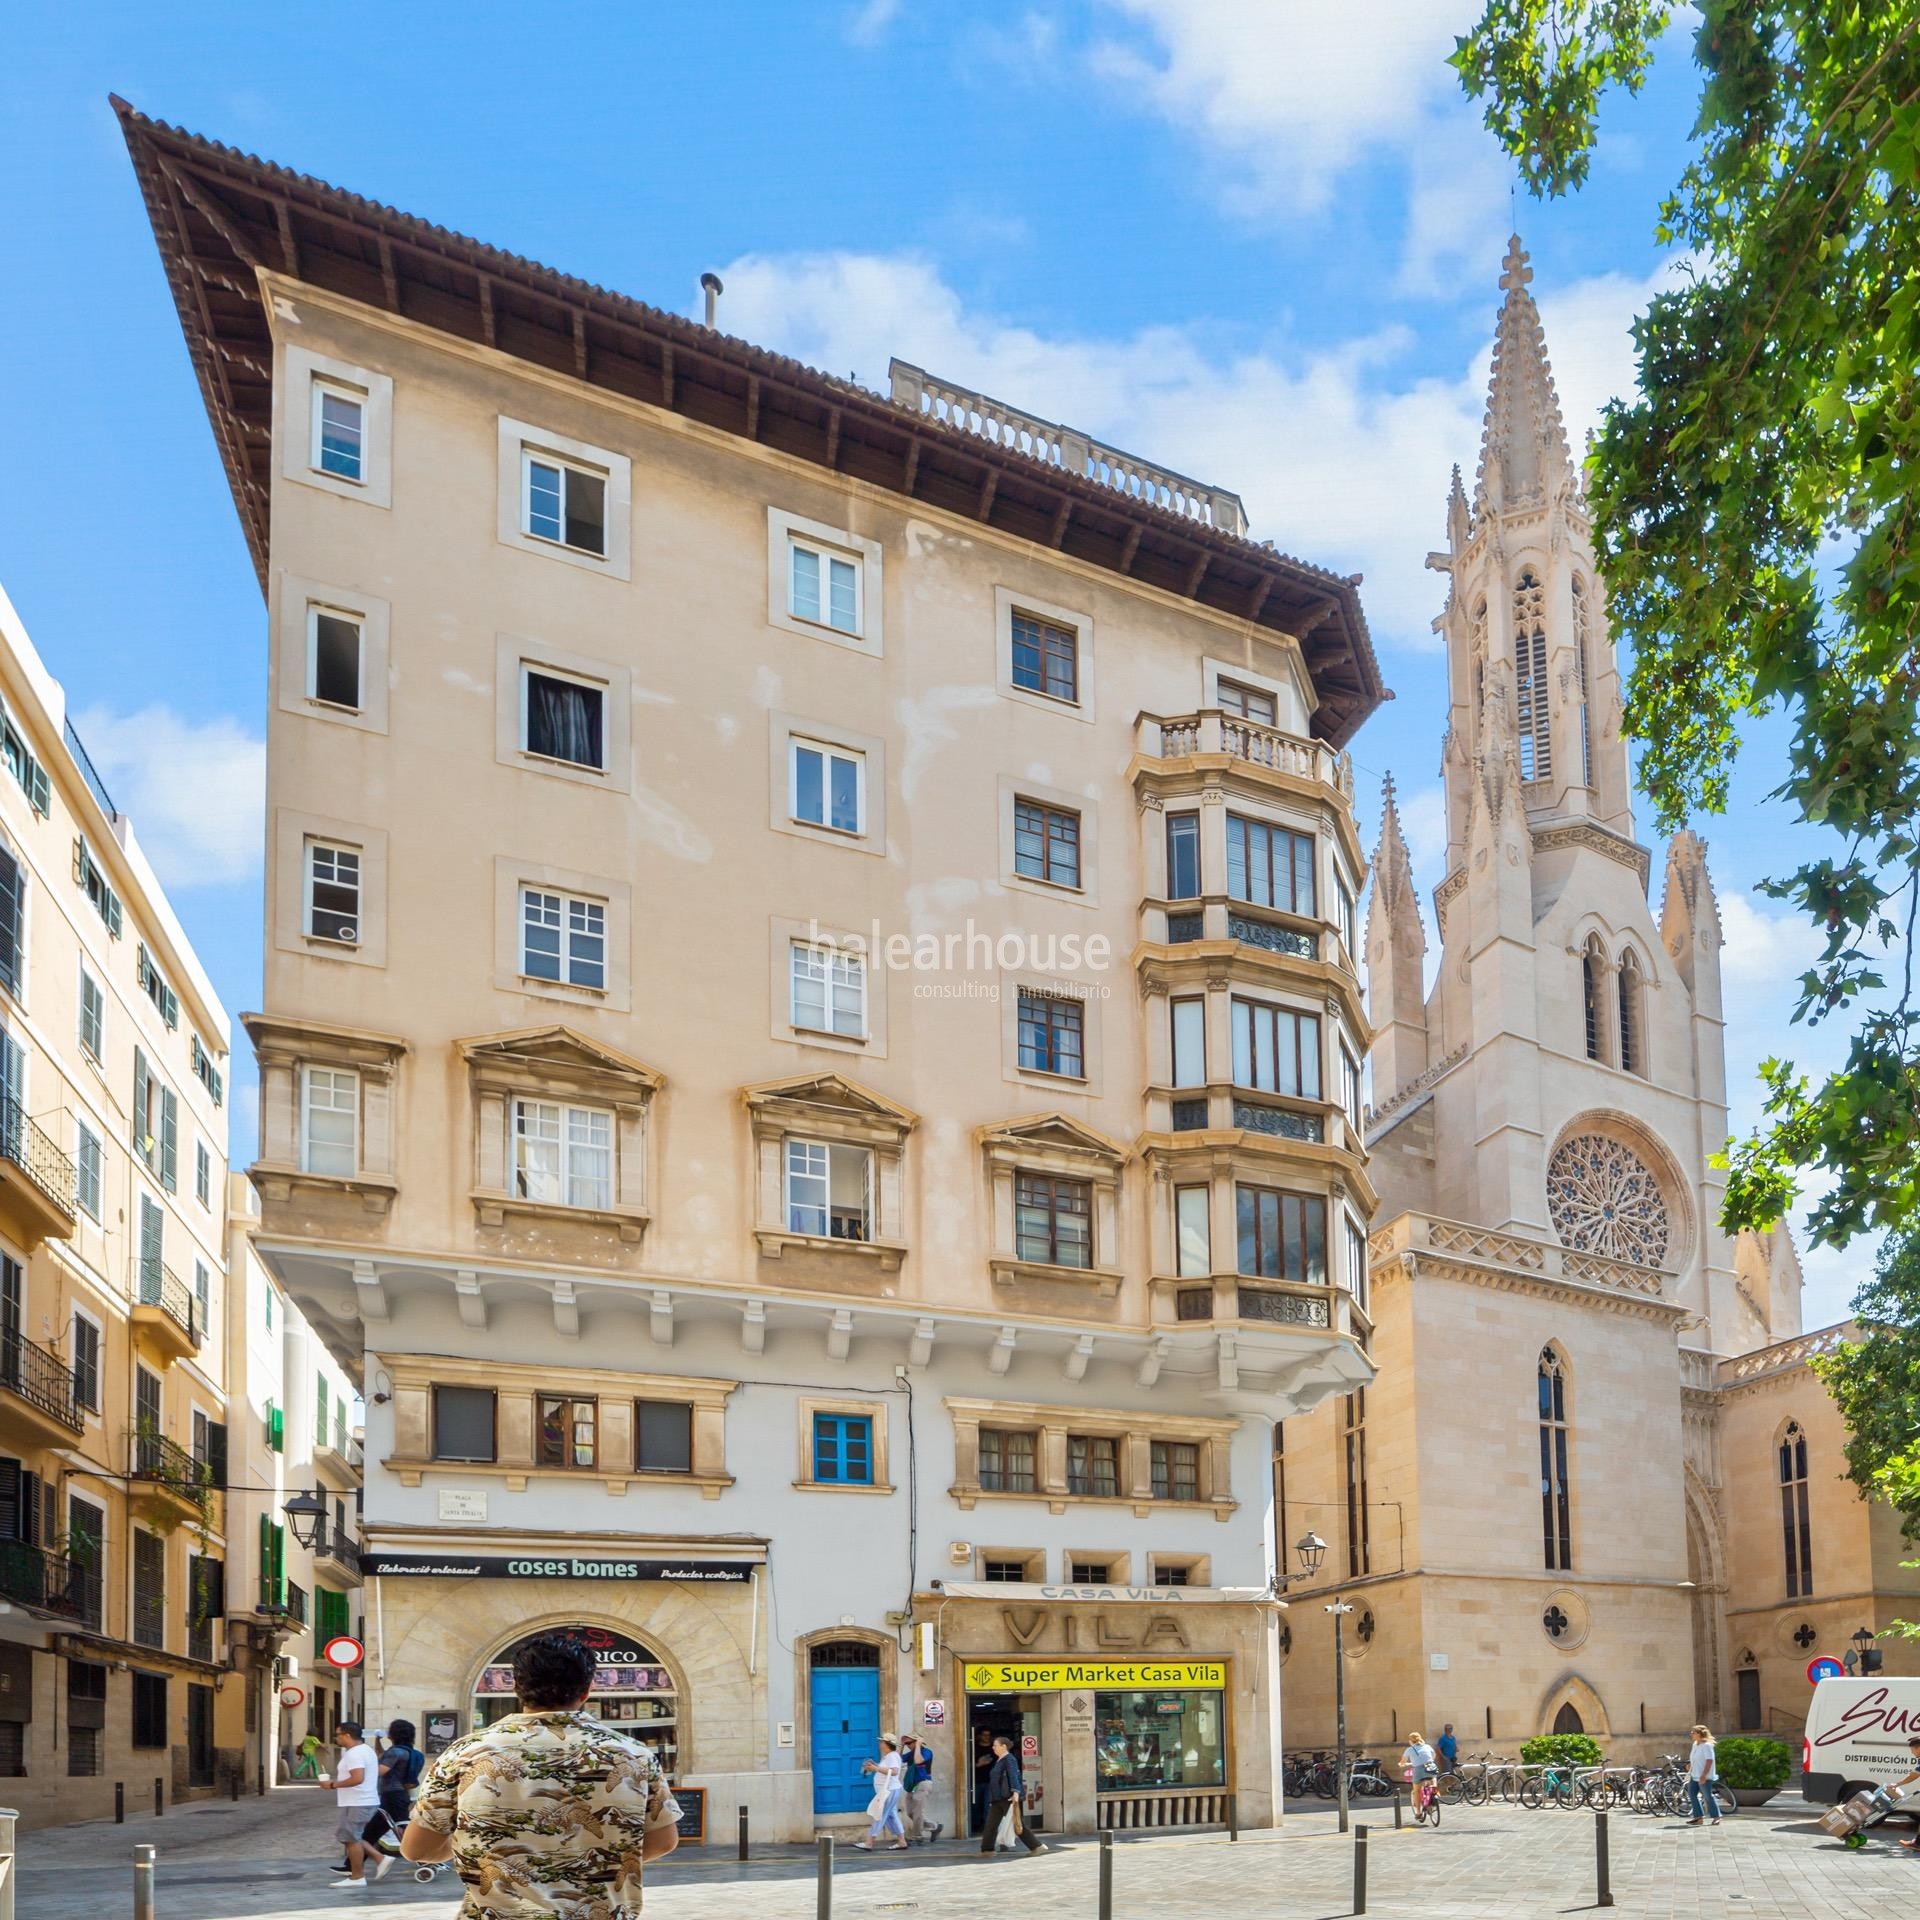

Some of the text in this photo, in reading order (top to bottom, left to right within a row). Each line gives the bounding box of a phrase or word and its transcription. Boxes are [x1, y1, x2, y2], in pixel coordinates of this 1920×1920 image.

[431, 1565, 481, 1575] artesanal
[508, 1559, 638, 1577] coses bones
[1041, 1587, 1183, 1600] CASA VILA
[1003, 1610, 1189, 1647] VILA
[594, 1651, 638, 1663] RICO
[1001, 1665, 1219, 1686] Super Market Casa Vila
[1845, 1754, 1908, 1765] DISTRIBUCIÓN
